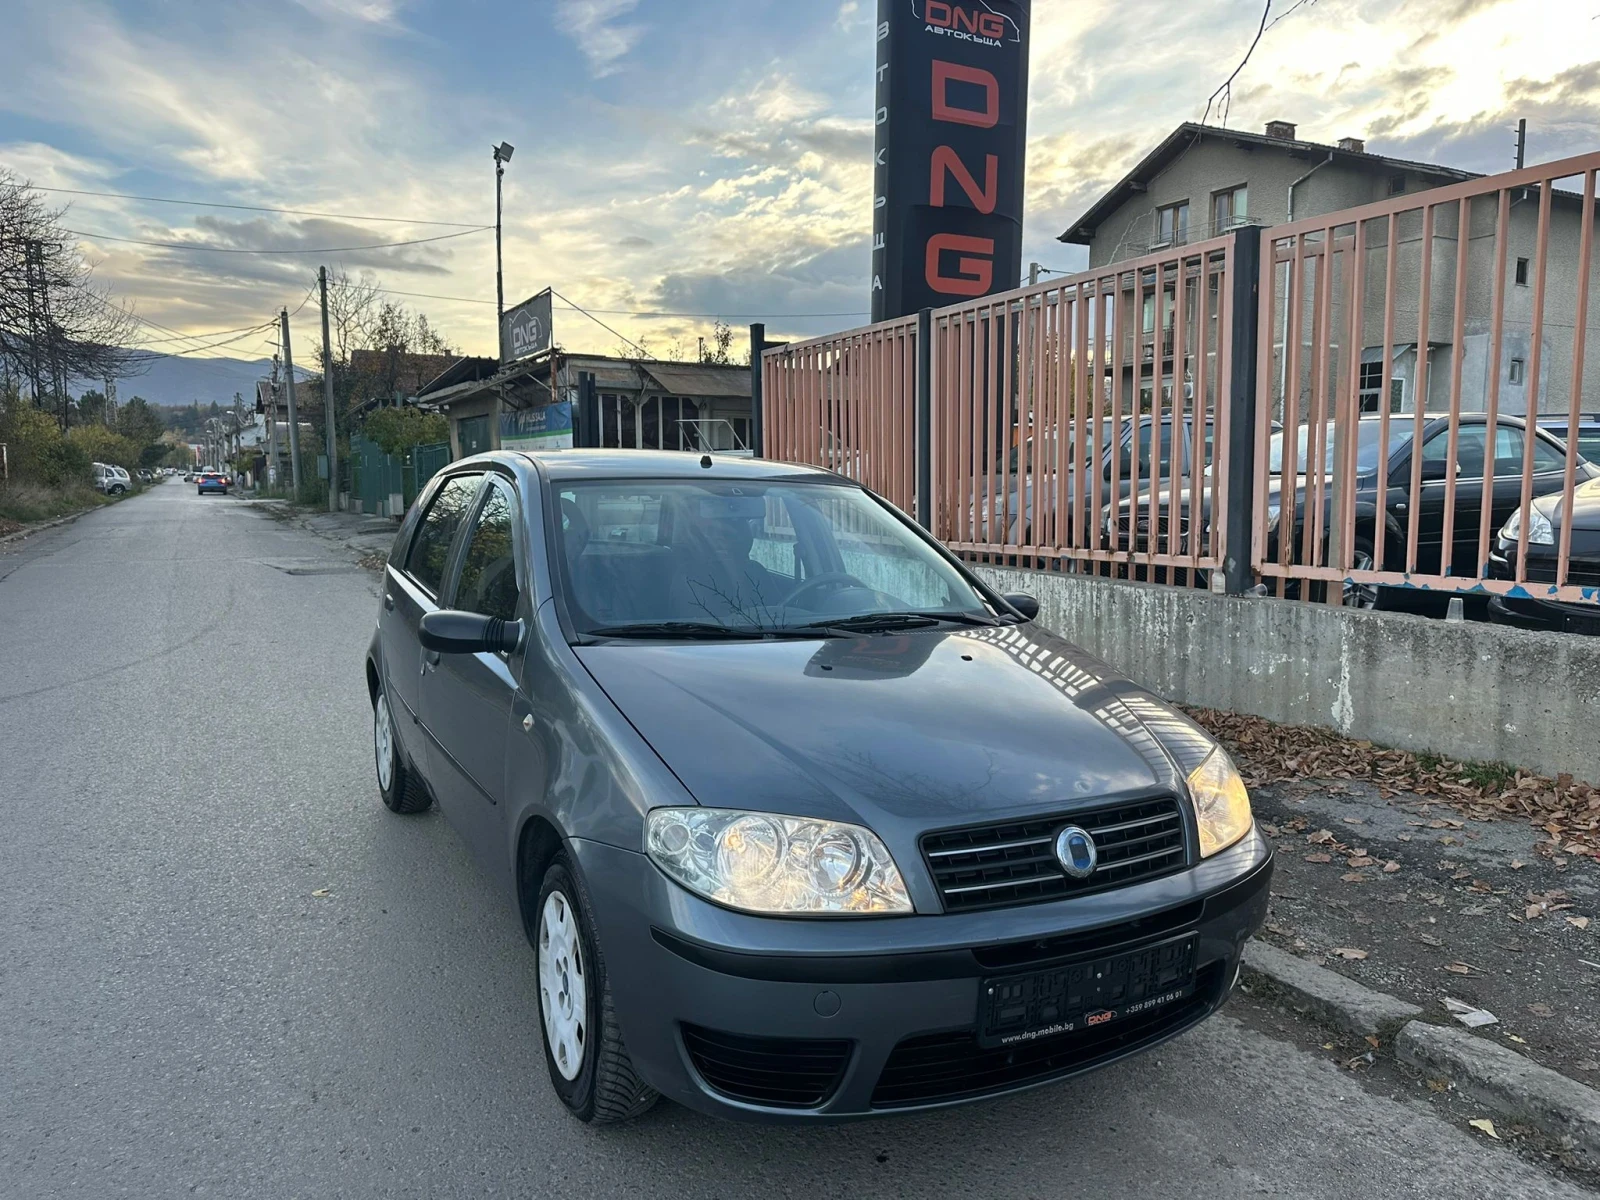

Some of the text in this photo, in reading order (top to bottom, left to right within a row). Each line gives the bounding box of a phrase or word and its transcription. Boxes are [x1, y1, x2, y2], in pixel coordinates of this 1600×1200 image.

[925, 0, 1004, 39] DNG
[924, 24, 1002, 48] АВТОКЪША
[925, 59, 999, 296] DNG
[513, 319, 537, 349] DNG
[1088, 1011, 1112, 1025] DNG
[1125, 1003, 1143, 1014] +359
[1001, 1022, 1074, 1043] www.dng.mobile.bg
